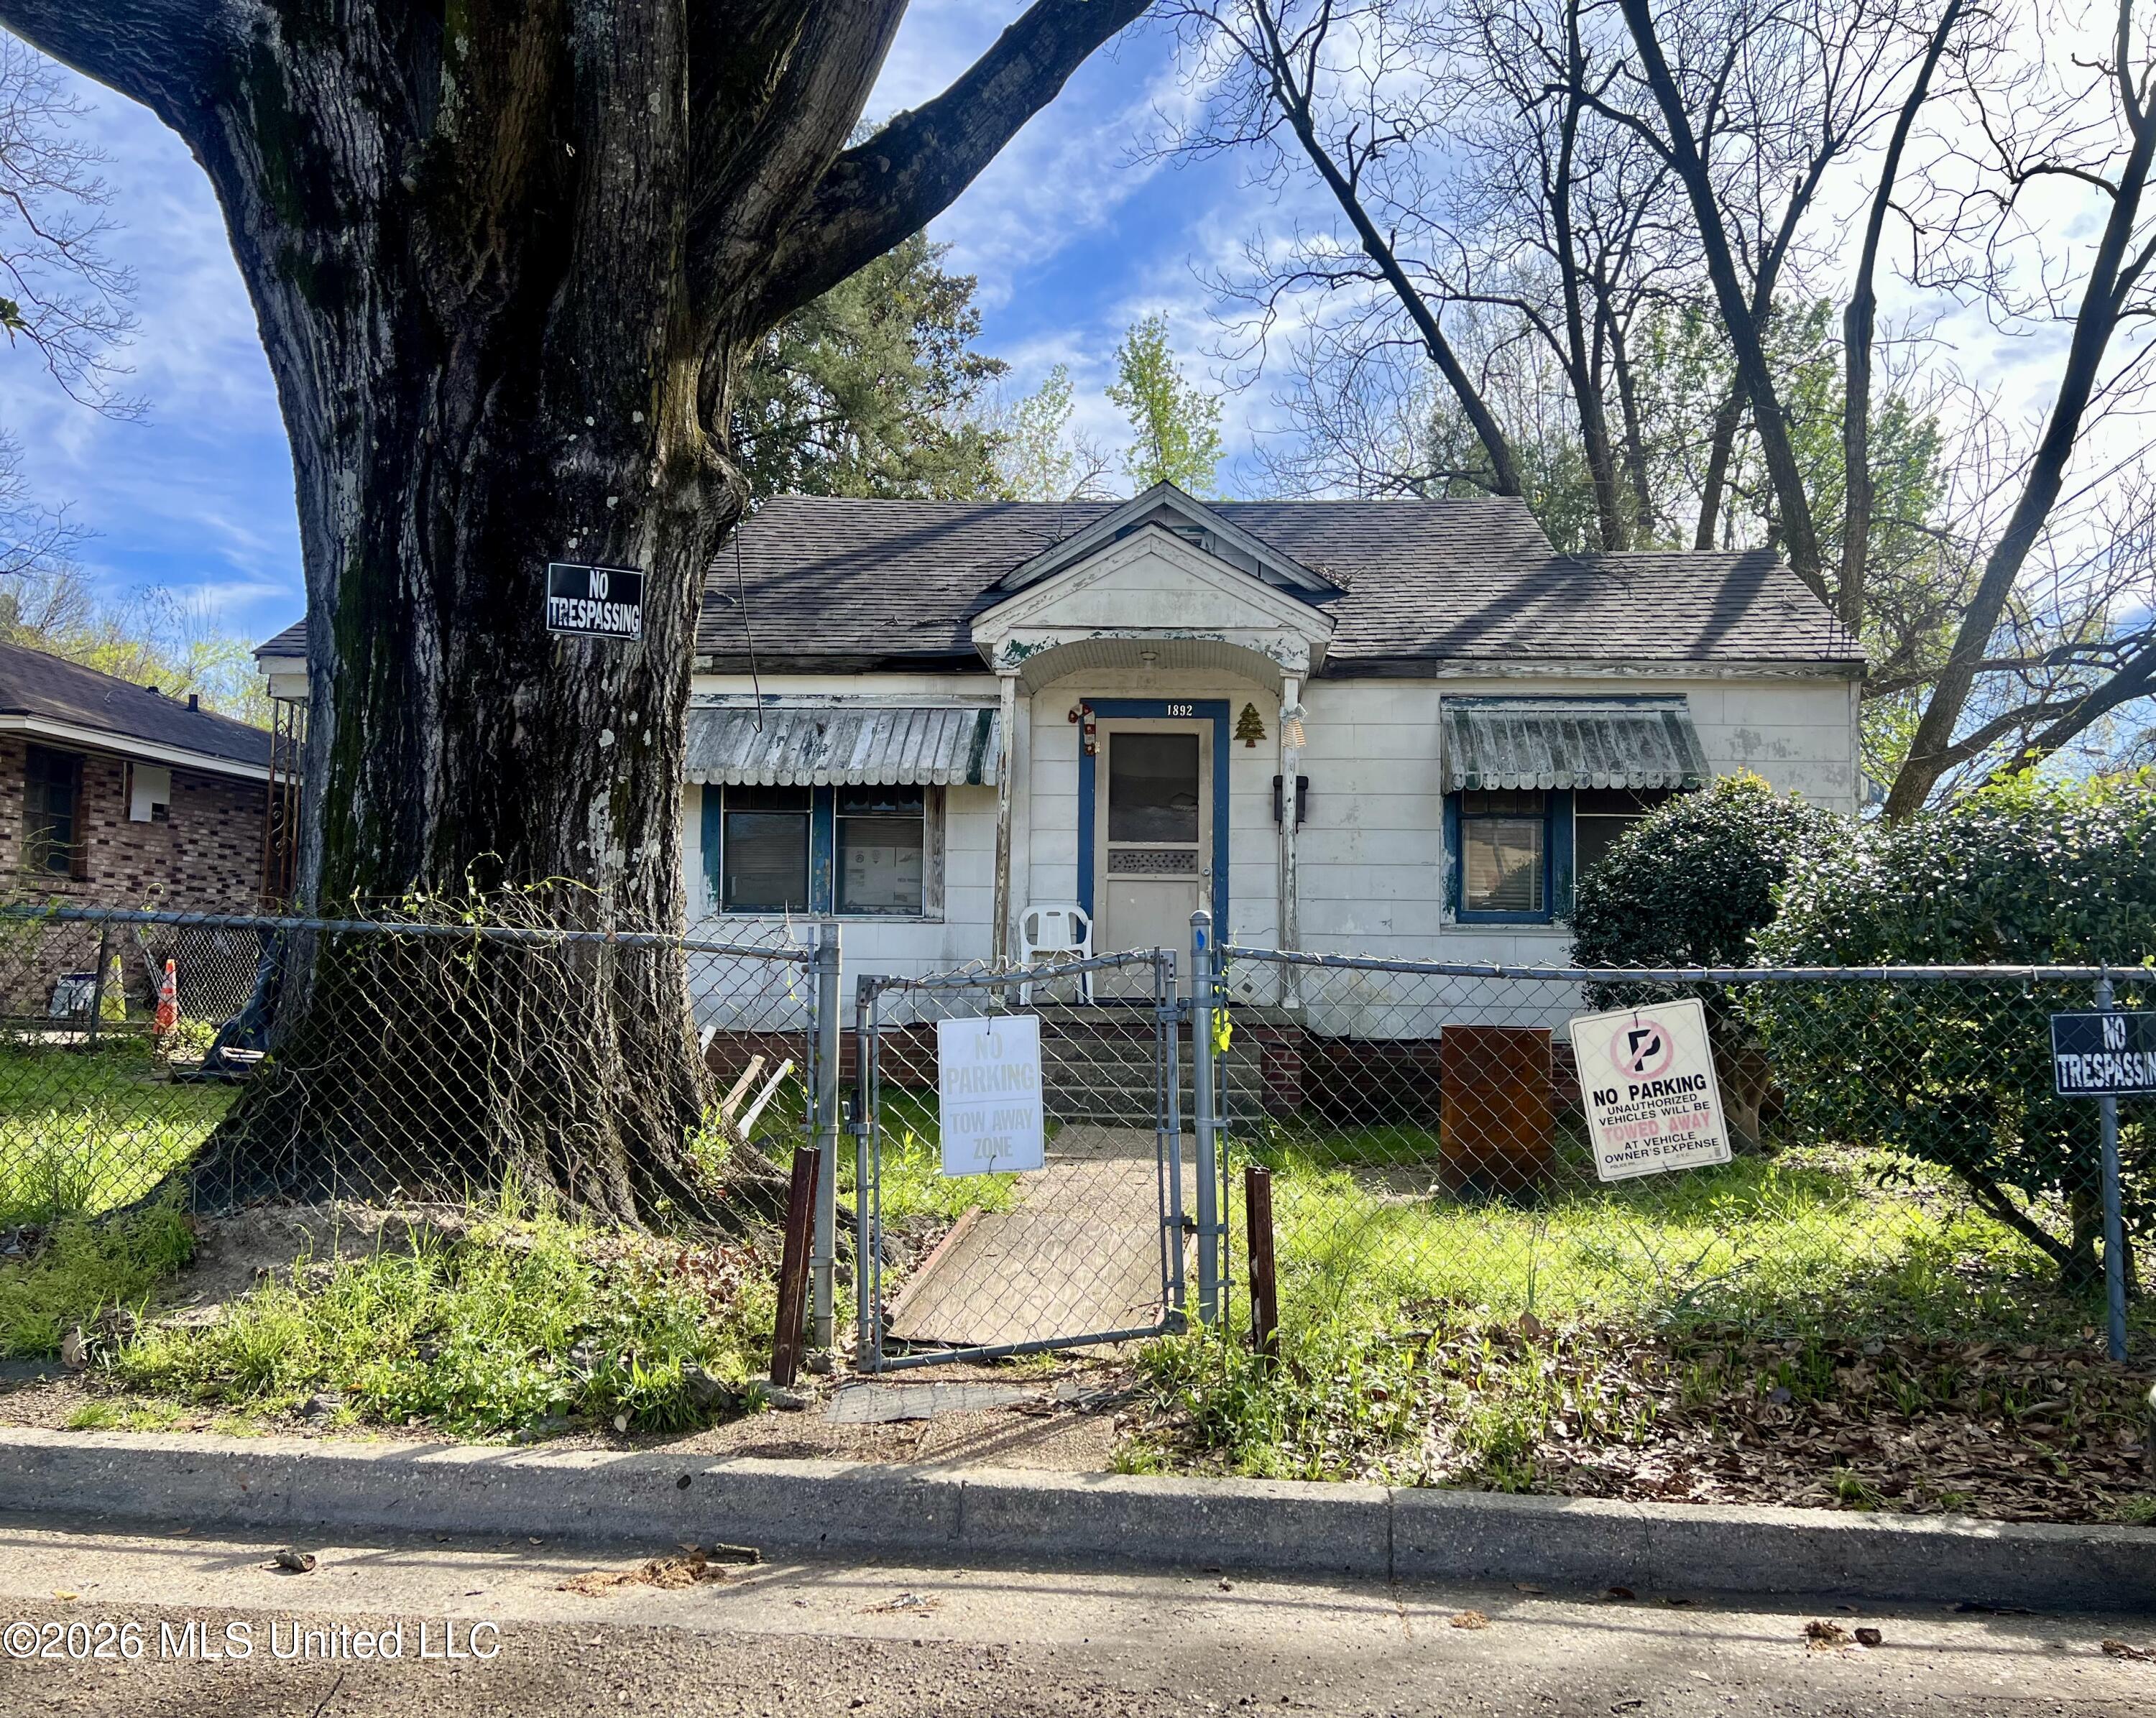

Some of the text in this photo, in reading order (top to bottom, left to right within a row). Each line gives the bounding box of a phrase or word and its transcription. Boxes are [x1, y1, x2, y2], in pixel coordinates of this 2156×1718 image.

[589, 570, 609, 599] NO
[550, 596, 640, 632] TRESPASSING
[1167, 704, 1193, 716] 1892
[975, 1031, 1003, 1060] NO
[2101, 1016, 2127, 1050] NO
[946, 1062, 1035, 1095] PARKING
[1593, 1073, 1707, 1107] NO PARKING
[1599, 1101, 1711, 1127] VEHICLES WILL BE
[1607, 1093, 1697, 1115] UNAUTHORIZED
[949, 1108, 1034, 1134] TOW AWAY
[1602, 1112, 1711, 1145] TOWED AWAY
[973, 1135, 1013, 1160] ZONE
[1604, 1147, 1661, 1163] OWNER'S
[1663, 1137, 1720, 1154] EXPENSE
[1624, 1131, 1696, 1150] AT VEHICLE
